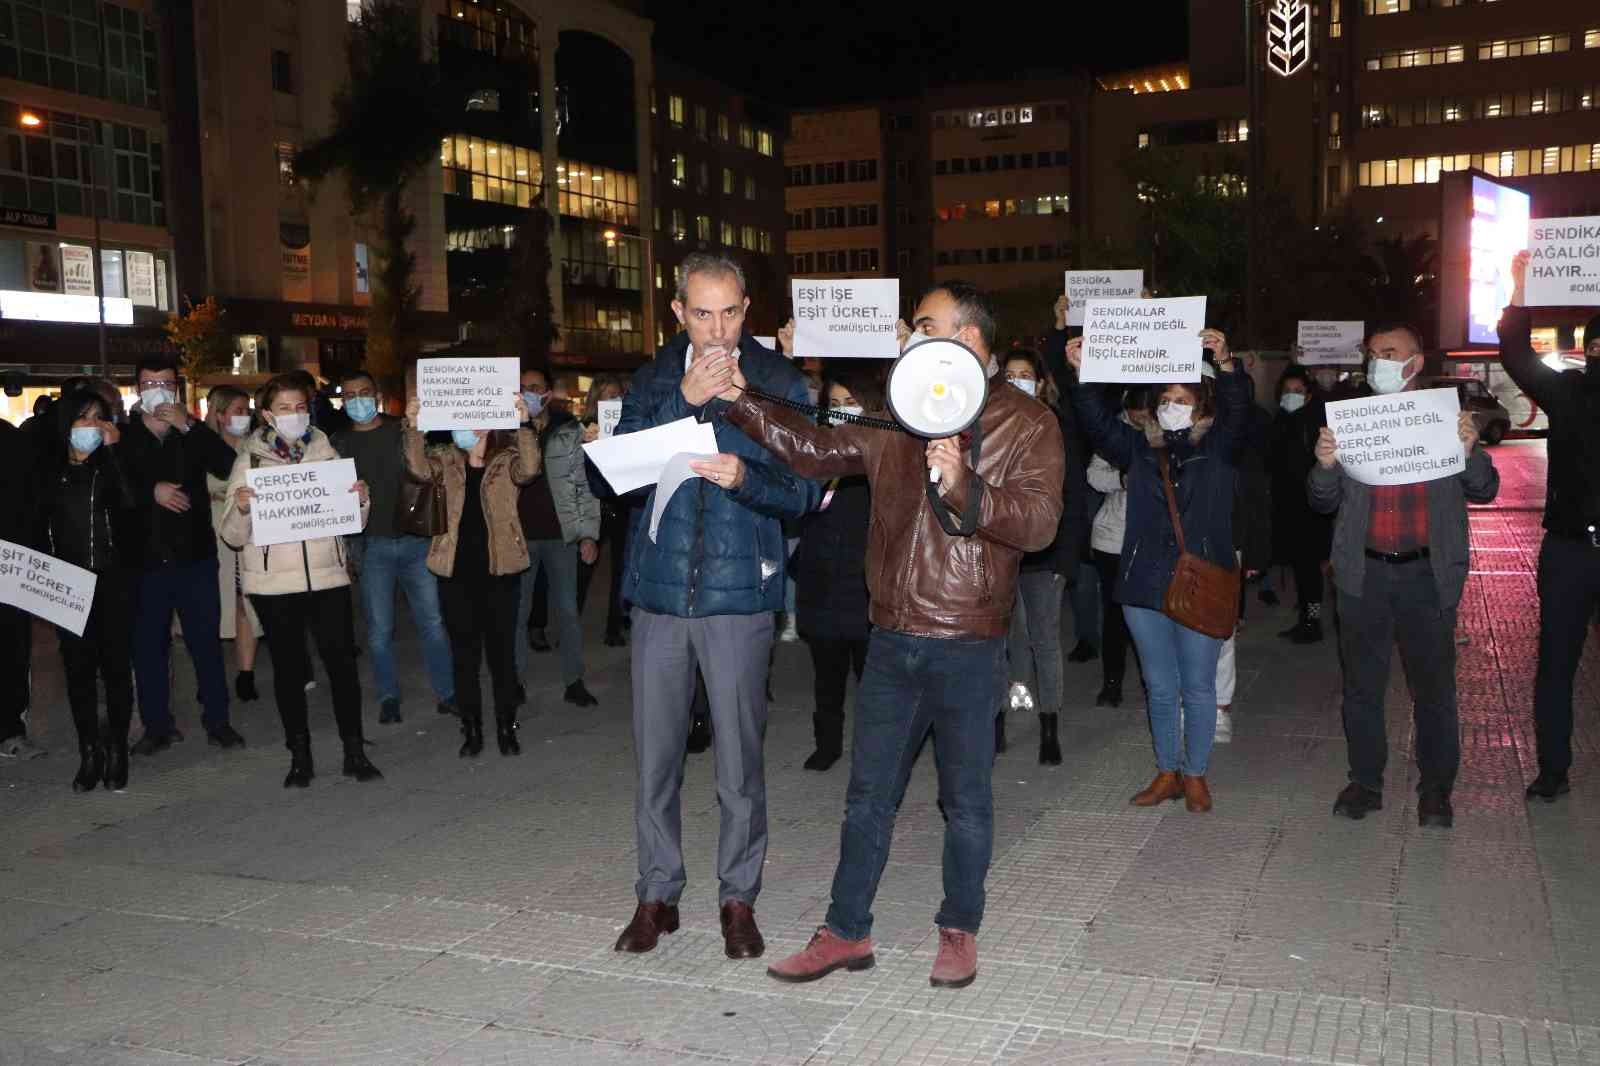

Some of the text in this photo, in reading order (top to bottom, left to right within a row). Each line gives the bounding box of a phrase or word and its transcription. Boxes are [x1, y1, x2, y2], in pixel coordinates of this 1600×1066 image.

[1532, 265, 1597, 278] HAYIR...
[1069, 275, 1112, 285] SENDİKA
[798, 287, 853, 302] EŞİT İŞE
[1069, 287, 1100, 297] İŞÇİYE
[798, 305, 892, 320] EŞİT ÜCRET...
[1091, 306, 1166, 317] SENDİKALAR
[1090, 319, 1187, 331] AĞALARIN DEĞİL
[1089, 335, 1138, 345] GERÇEK
[423, 365, 477, 374] SENDİKAYA
[477, 386, 503, 396] KÖLE
[1334, 401, 1415, 420] SENDİKALAR
[1336, 411, 1444, 435] AĞALARIN DEĞİL
[1338, 435, 1391, 450] GERÇEK
[254, 471, 318, 489] ÇERÇEVE
[256, 487, 330, 504] PROTOKOL
[257, 503, 334, 520] HAKKIMIZ...
[0, 548, 51, 572] ŞİT İŞE
